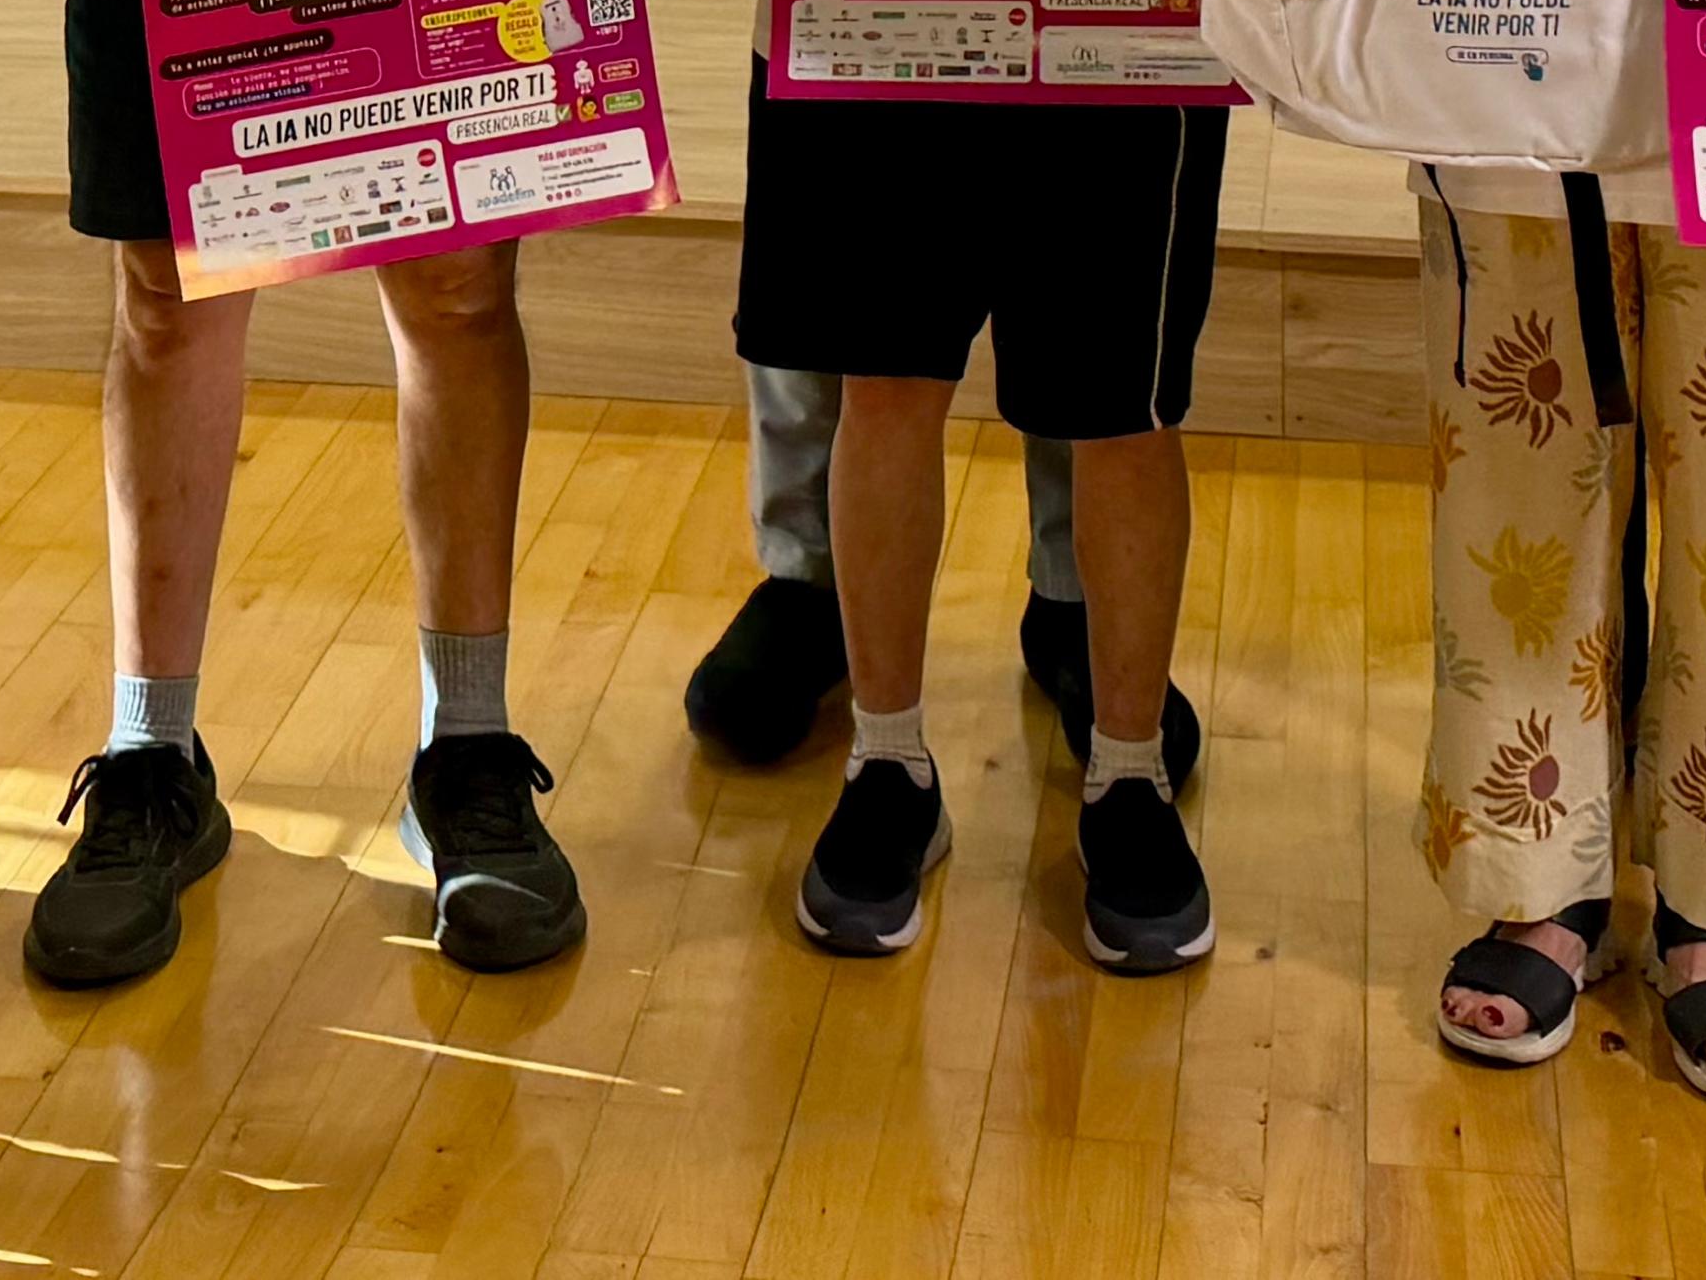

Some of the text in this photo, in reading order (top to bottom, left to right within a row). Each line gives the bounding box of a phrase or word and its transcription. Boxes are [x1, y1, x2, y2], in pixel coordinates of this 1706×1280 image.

[1432, 11, 1559, 36] VENIR POR TI
